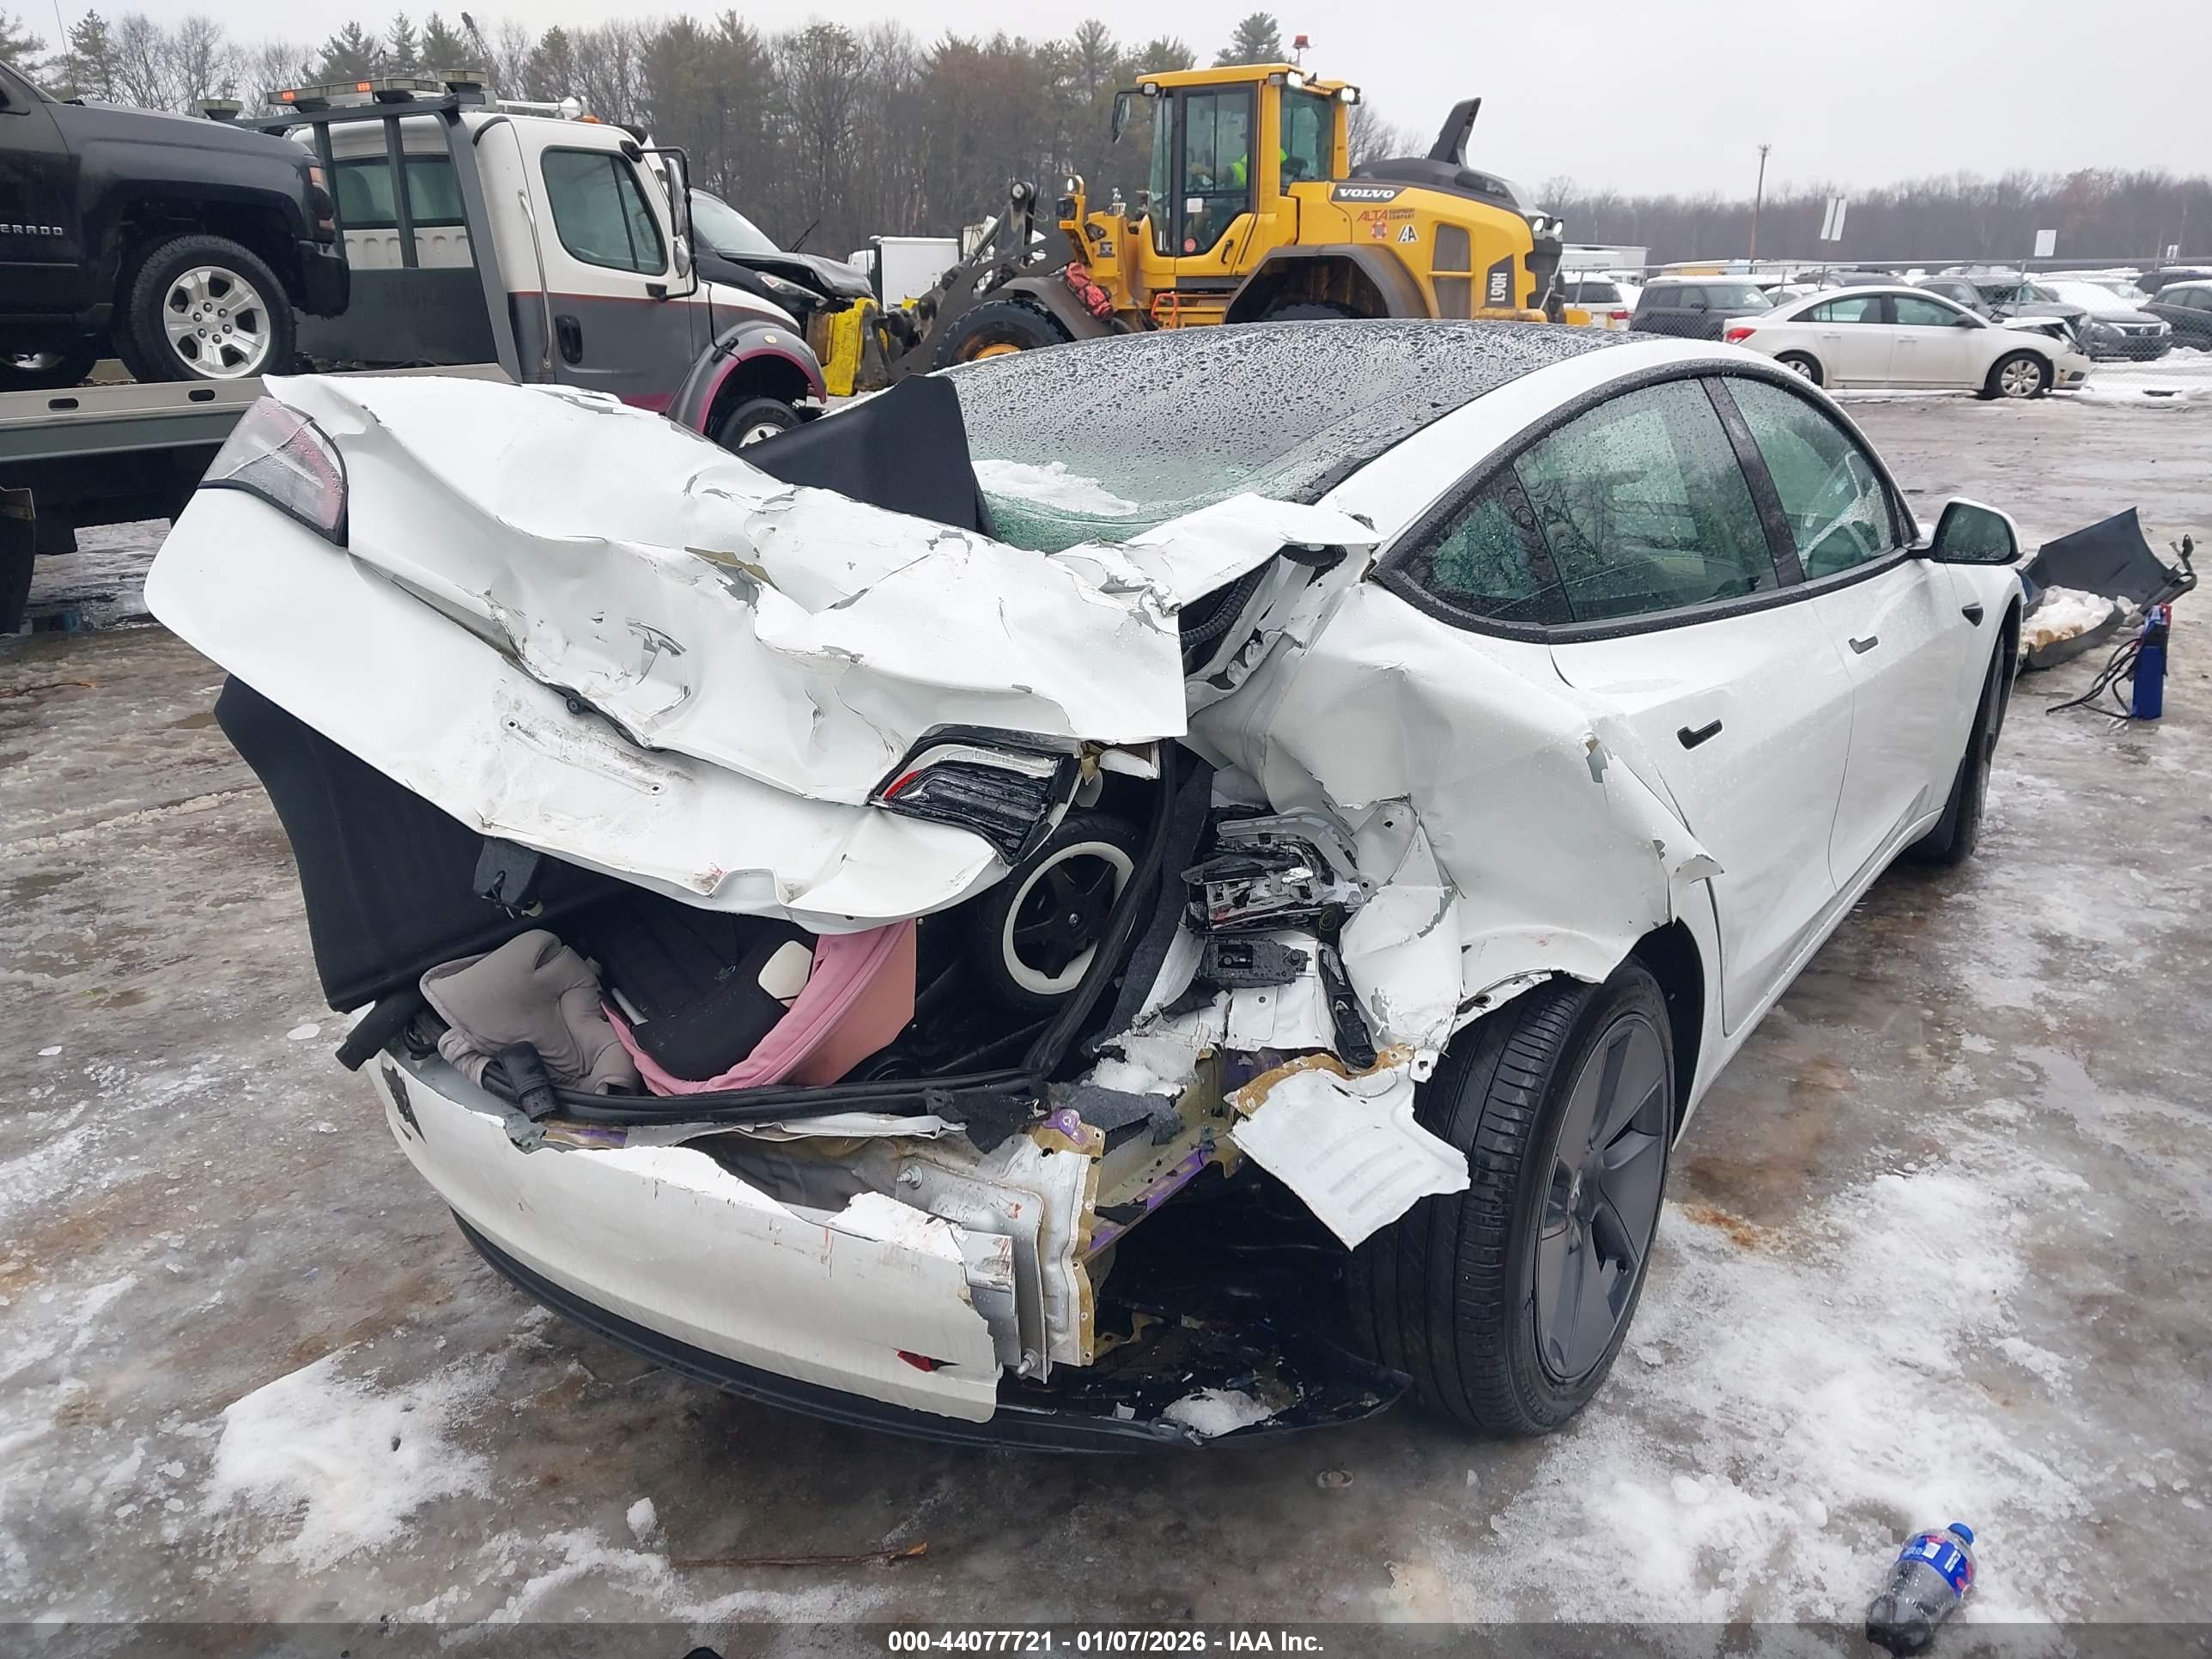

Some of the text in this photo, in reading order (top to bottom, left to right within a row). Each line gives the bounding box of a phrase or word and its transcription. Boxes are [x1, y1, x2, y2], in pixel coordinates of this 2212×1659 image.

[1339, 188, 1395, 198] VOLVO
[1357, 209, 1388, 222] ALTA
[1490, 272, 1508, 301] L90H
